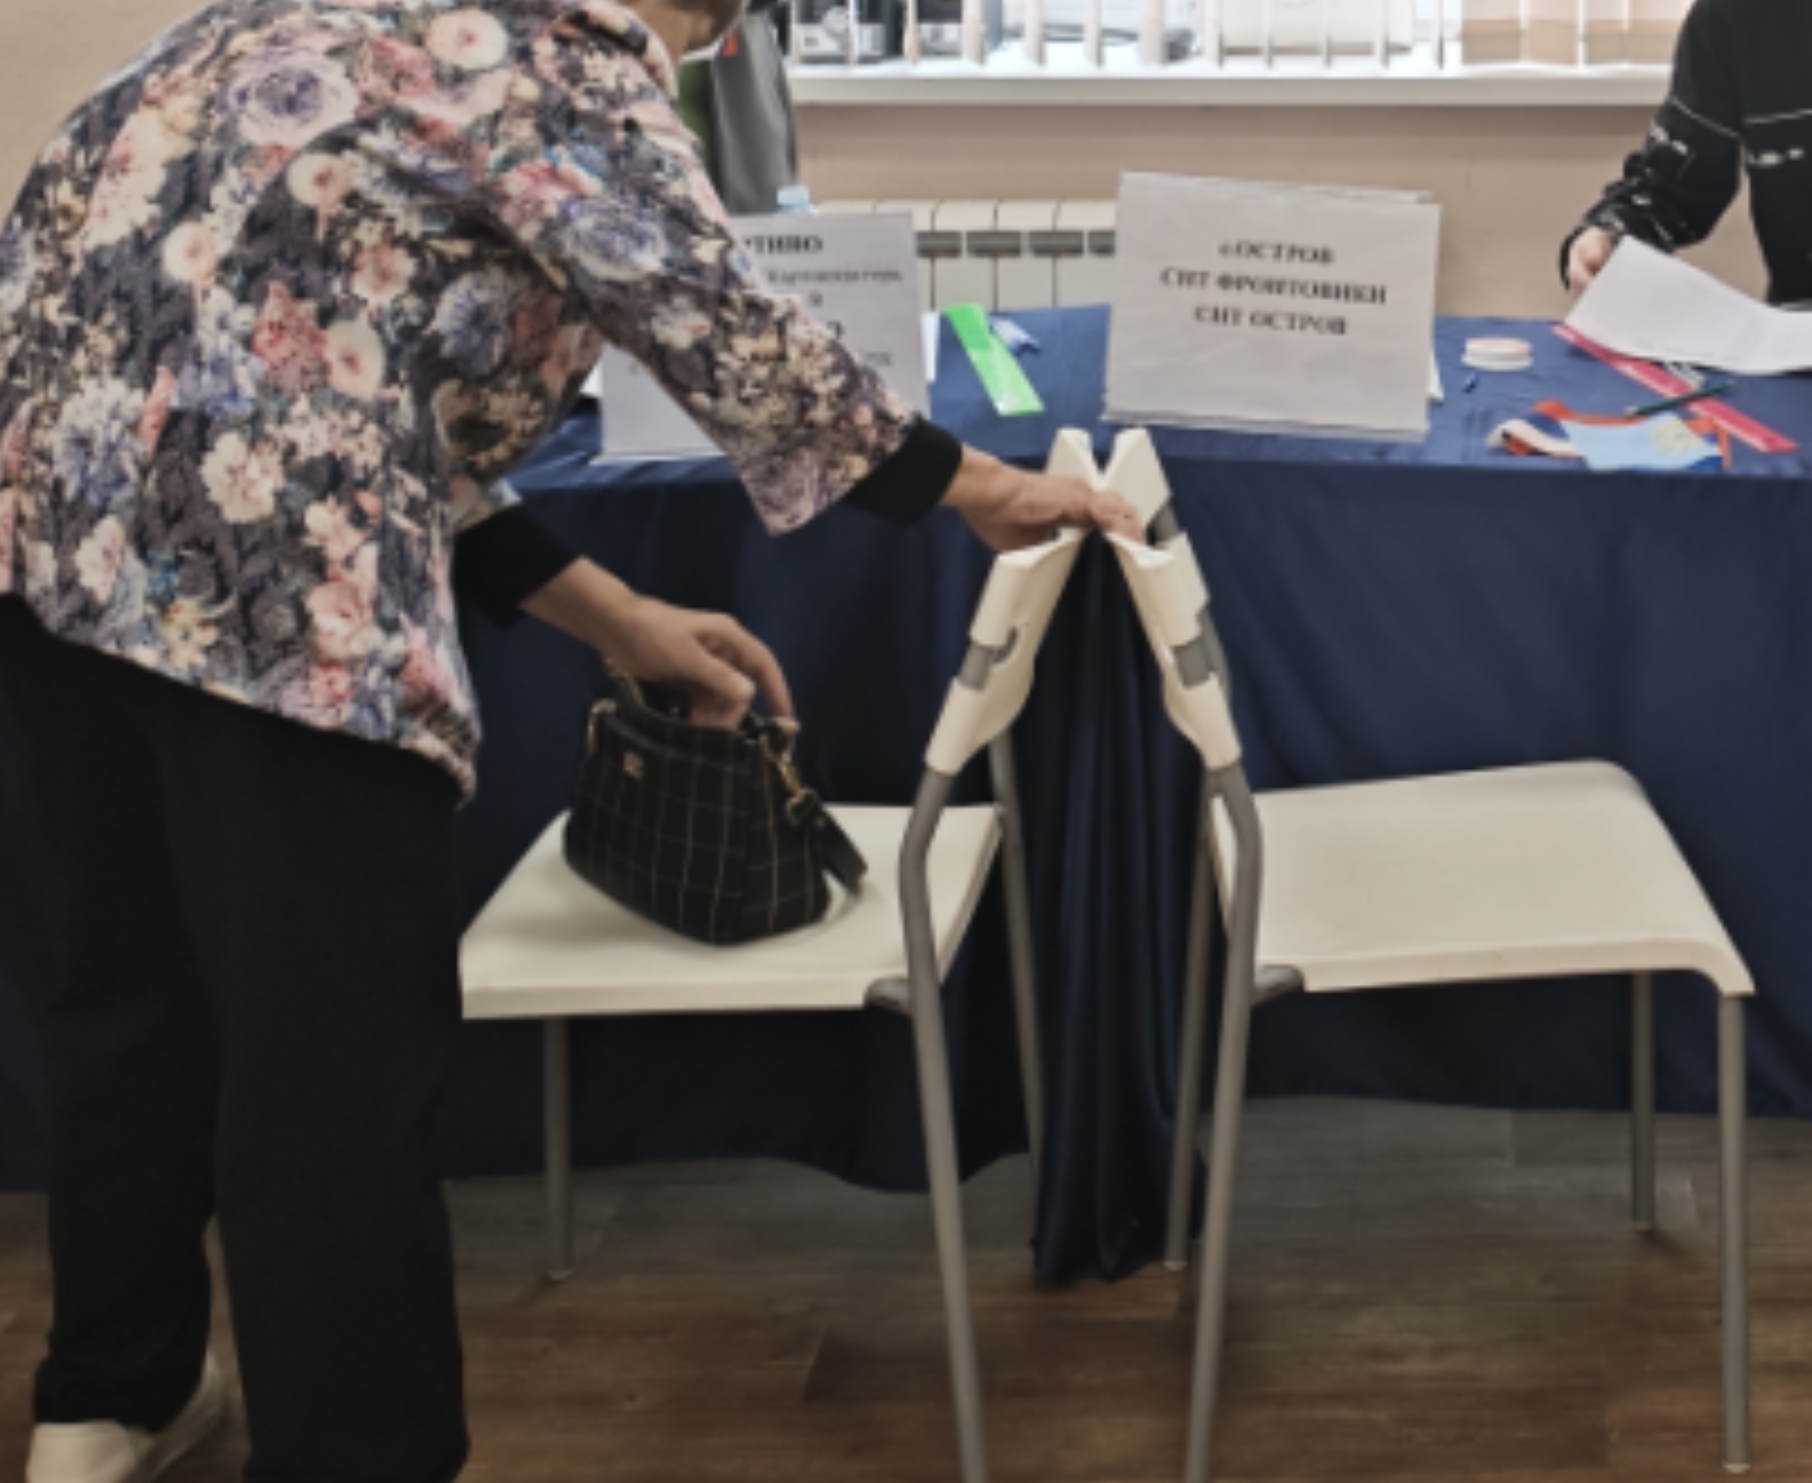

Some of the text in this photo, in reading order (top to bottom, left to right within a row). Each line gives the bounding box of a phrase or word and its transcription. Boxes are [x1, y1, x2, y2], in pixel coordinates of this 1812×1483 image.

[1159, 266, 1387, 304] СНТ ФРОНТОВИКИ
[1193, 305, 1347, 336] СНТ ОСТРОВ
